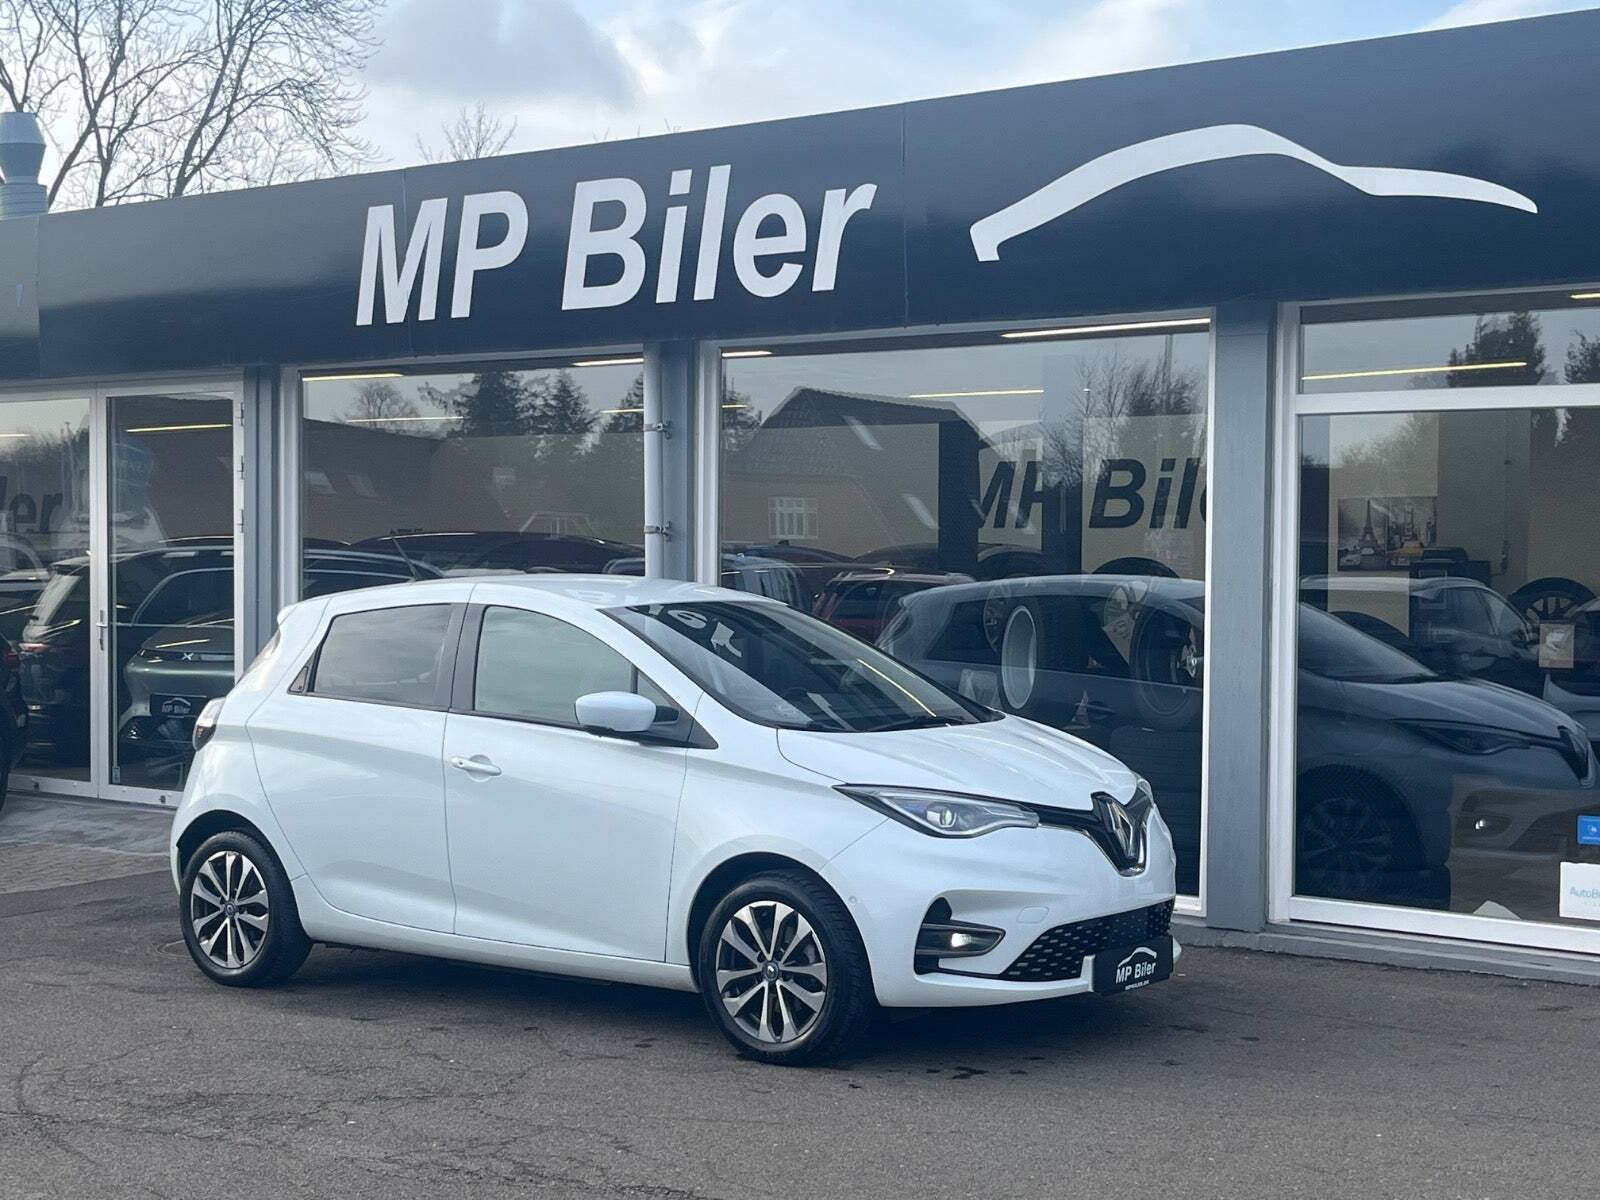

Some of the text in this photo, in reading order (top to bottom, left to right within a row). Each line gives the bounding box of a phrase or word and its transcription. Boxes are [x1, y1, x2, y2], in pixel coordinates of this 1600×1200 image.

[355, 164, 878, 326] MP Biler
[1088, 457, 1207, 529] Bil
[1569, 886, 1600, 899] AutoB
[1115, 961, 1156, 984] MP Biler
